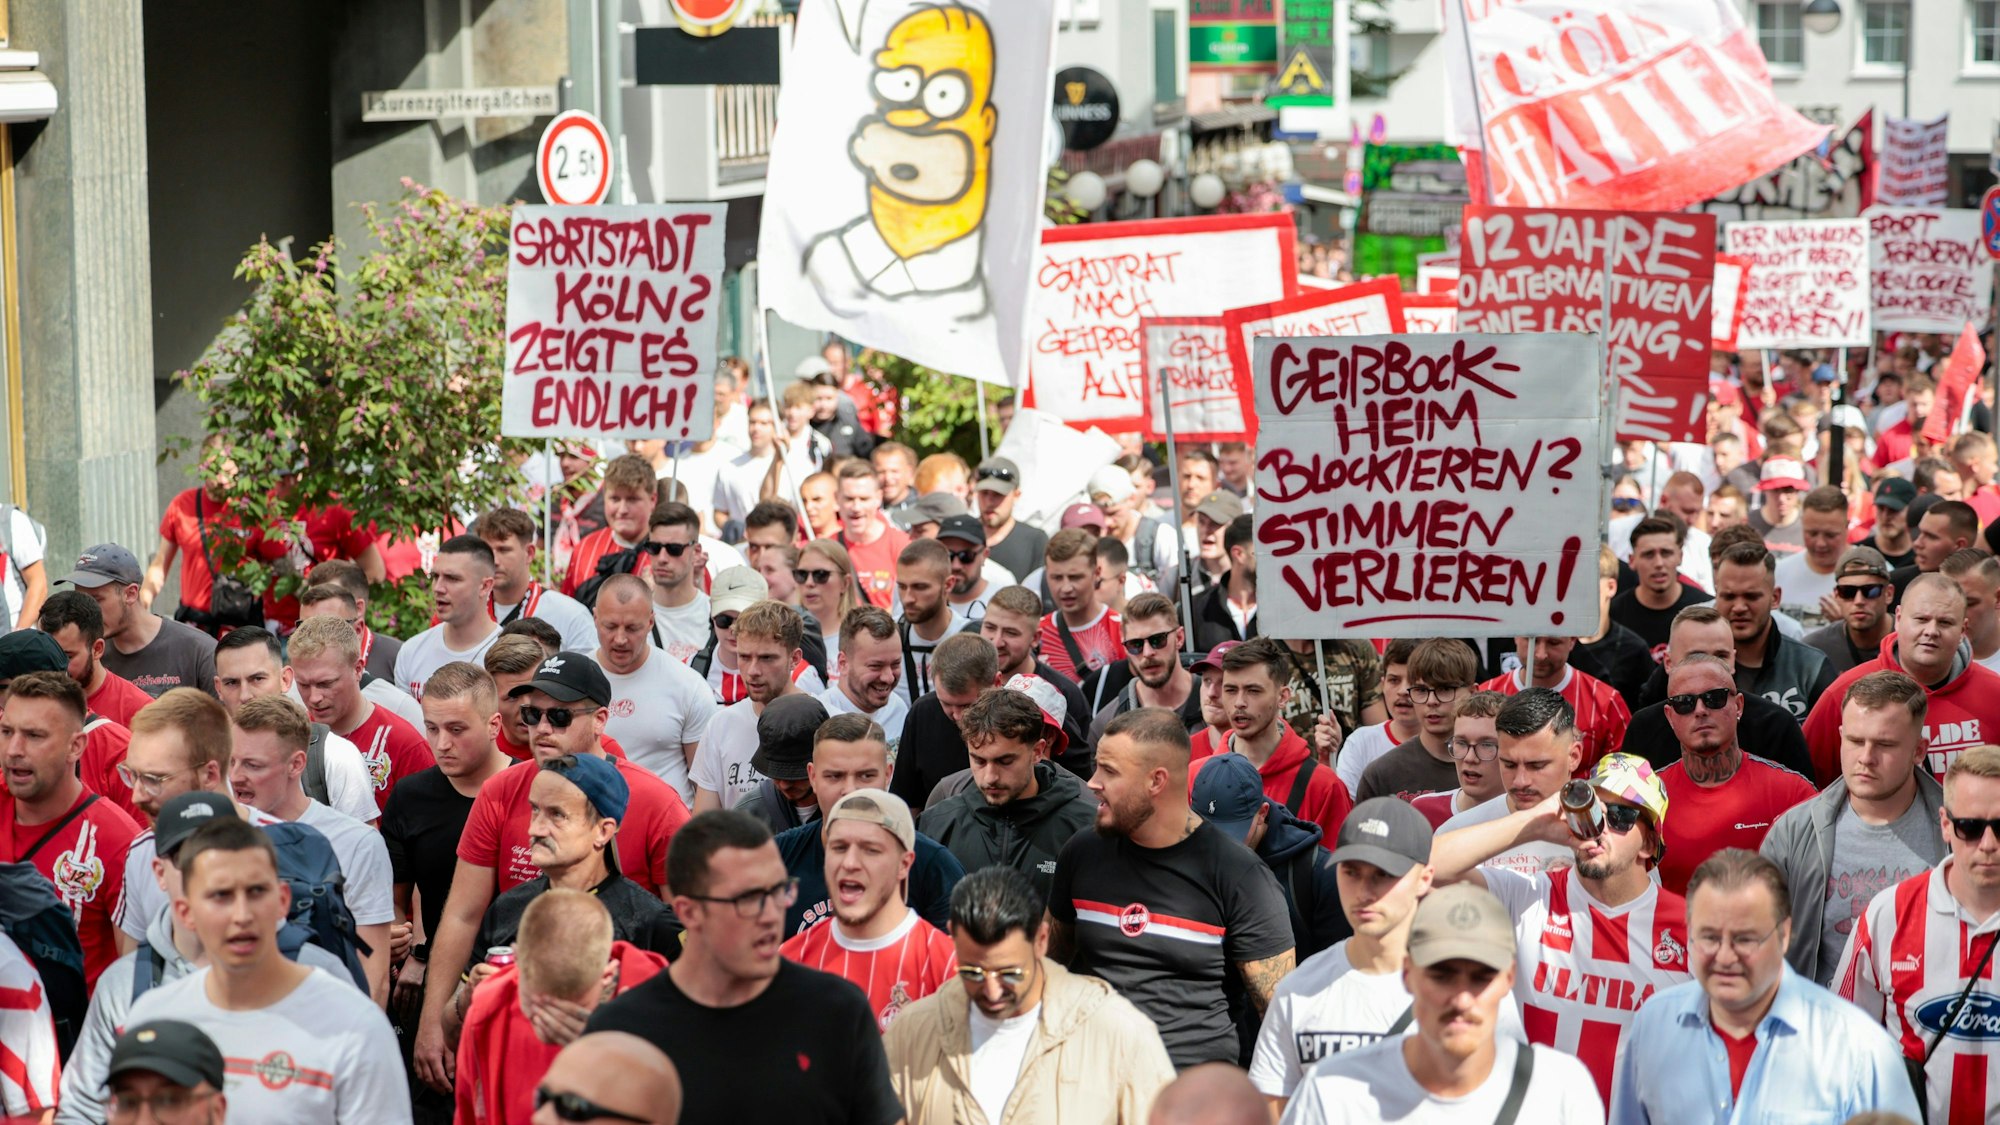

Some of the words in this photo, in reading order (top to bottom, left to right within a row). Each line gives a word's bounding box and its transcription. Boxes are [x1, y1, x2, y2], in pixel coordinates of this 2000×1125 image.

[513, 214, 711, 273] SPORTSTADT
[1038, 252, 1182, 292] STADTRAT
[1468, 214, 1520, 267] 12
[1524, 213, 1702, 279] JAHRE
[556, 272, 711, 326] KÖLN?
[1073, 286, 1158, 319] MACH
[510, 322, 634, 375] ZEIGT
[641, 332, 698, 379] ES
[1037, 319, 1141, 359] GEIßBO
[532, 376, 697, 437] ENDLICH!
[1270, 340, 1521, 415] GEIßBOCK-
[1334, 389, 1482, 455] HEIM
[1258, 437, 1582, 502] BLOCKIEREN?
[1258, 500, 1513, 557] STIMMEN
[1282, 536, 1582, 626] VERLIEREN!
[1921, 719, 1981, 746] LDE
